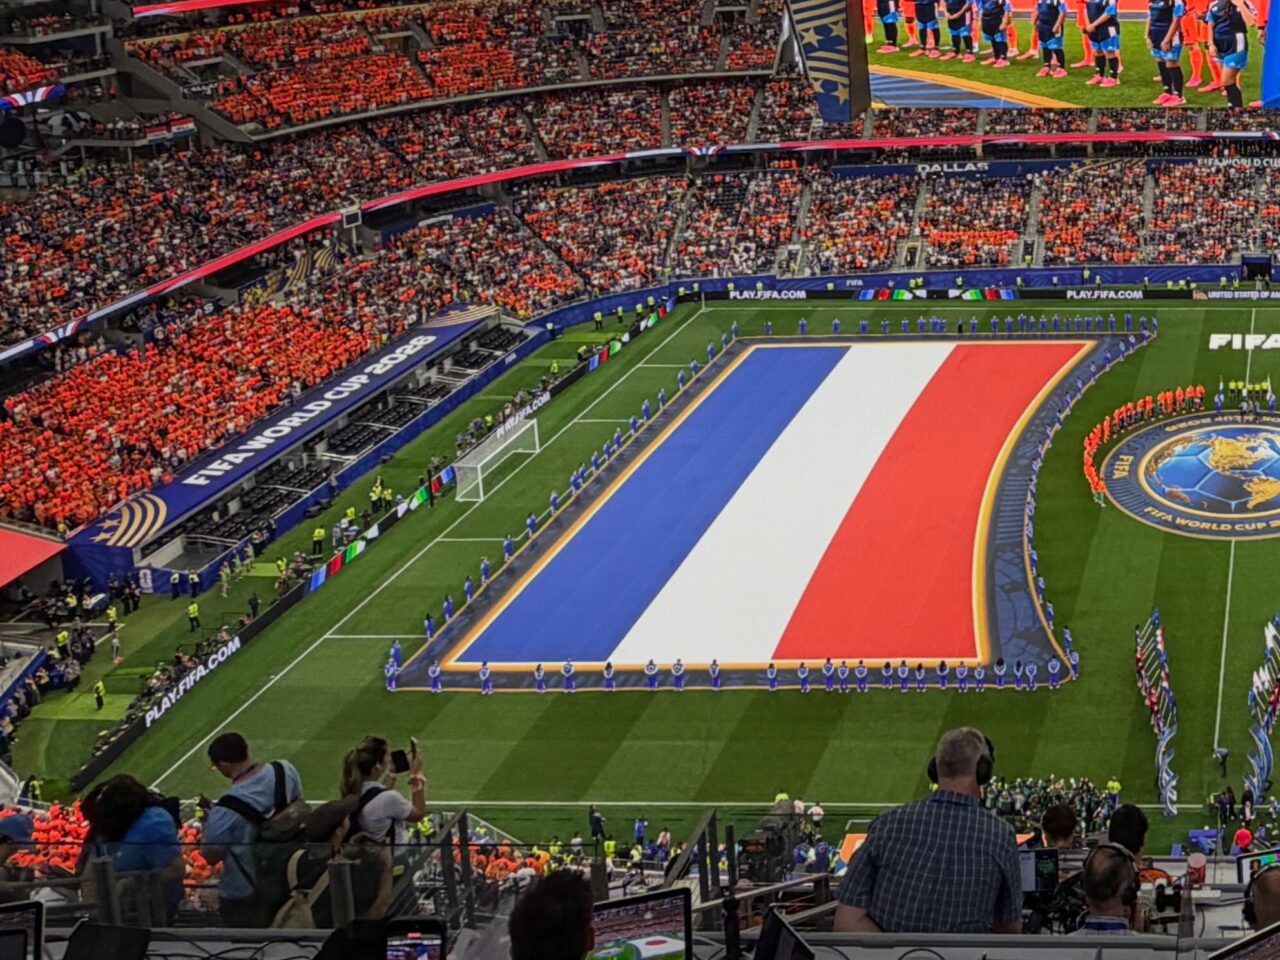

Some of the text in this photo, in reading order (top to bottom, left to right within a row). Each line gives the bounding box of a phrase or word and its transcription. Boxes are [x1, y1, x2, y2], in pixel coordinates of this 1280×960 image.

[917, 162, 989, 173] DALLAS
[730, 290, 806, 300] PLAY.FIFA.COM
[1067, 290, 1143, 300] PLAY.FIFA.COM
[1208, 291, 1233, 299] UNITED
[1234, 291, 1259, 299] STATES
[1260, 291, 1270, 299] OF
[182, 334, 437, 487] FIFA WORLD CUP 2026
[1113, 454, 1134, 480] FIFA
[1143, 506, 1174, 524] FIFA
[1176, 517, 1231, 532] WORLD
[1234, 520, 1267, 532] CUP
[145, 636, 241, 728] PLAY.FIFA.COM
